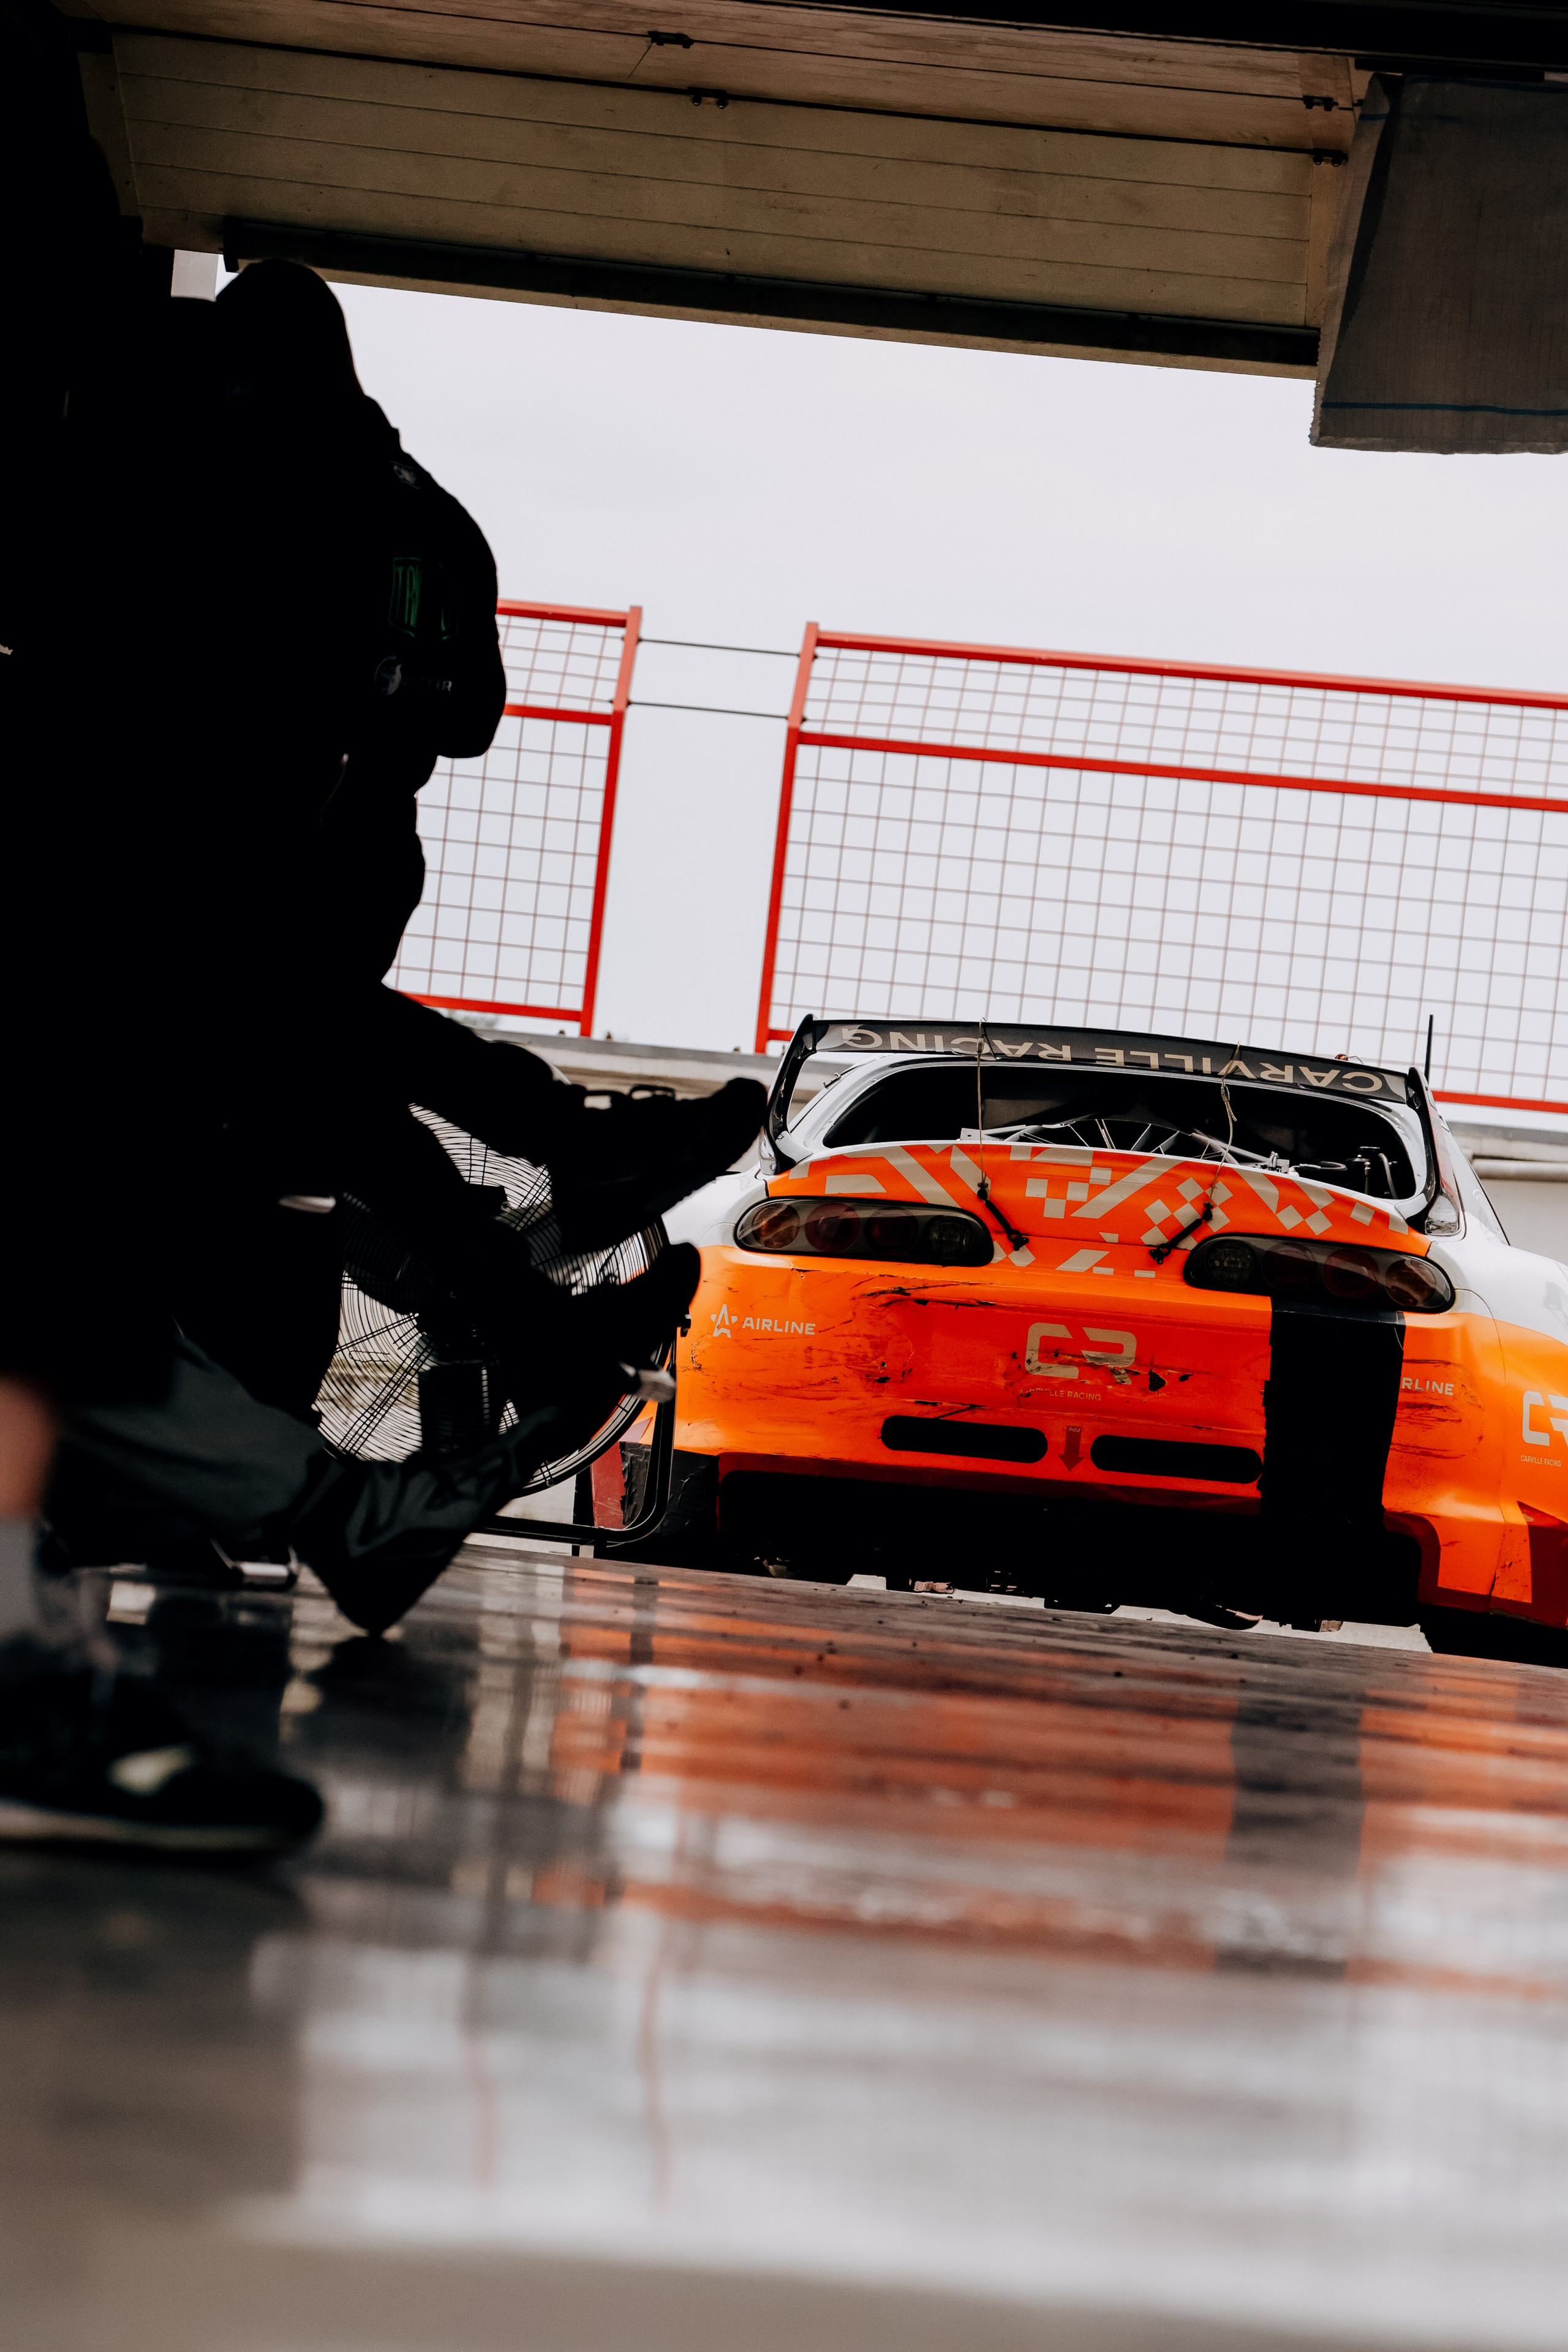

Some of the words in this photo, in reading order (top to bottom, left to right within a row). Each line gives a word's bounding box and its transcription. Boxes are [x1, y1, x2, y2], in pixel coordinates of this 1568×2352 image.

[842, 1028, 1071, 1061] RACING
[1095, 1047, 1384, 1093] CARVILLE
[742, 1317, 816, 1335] AIRLINE
[1025, 1322, 1137, 1385] CR
[1401, 1377, 1454, 1395] RLINE
[1067, 1391, 1101, 1401] RACING
[1520, 1455, 1543, 1465] CARVILLE
[1544, 1458, 1562, 1468] RACING
